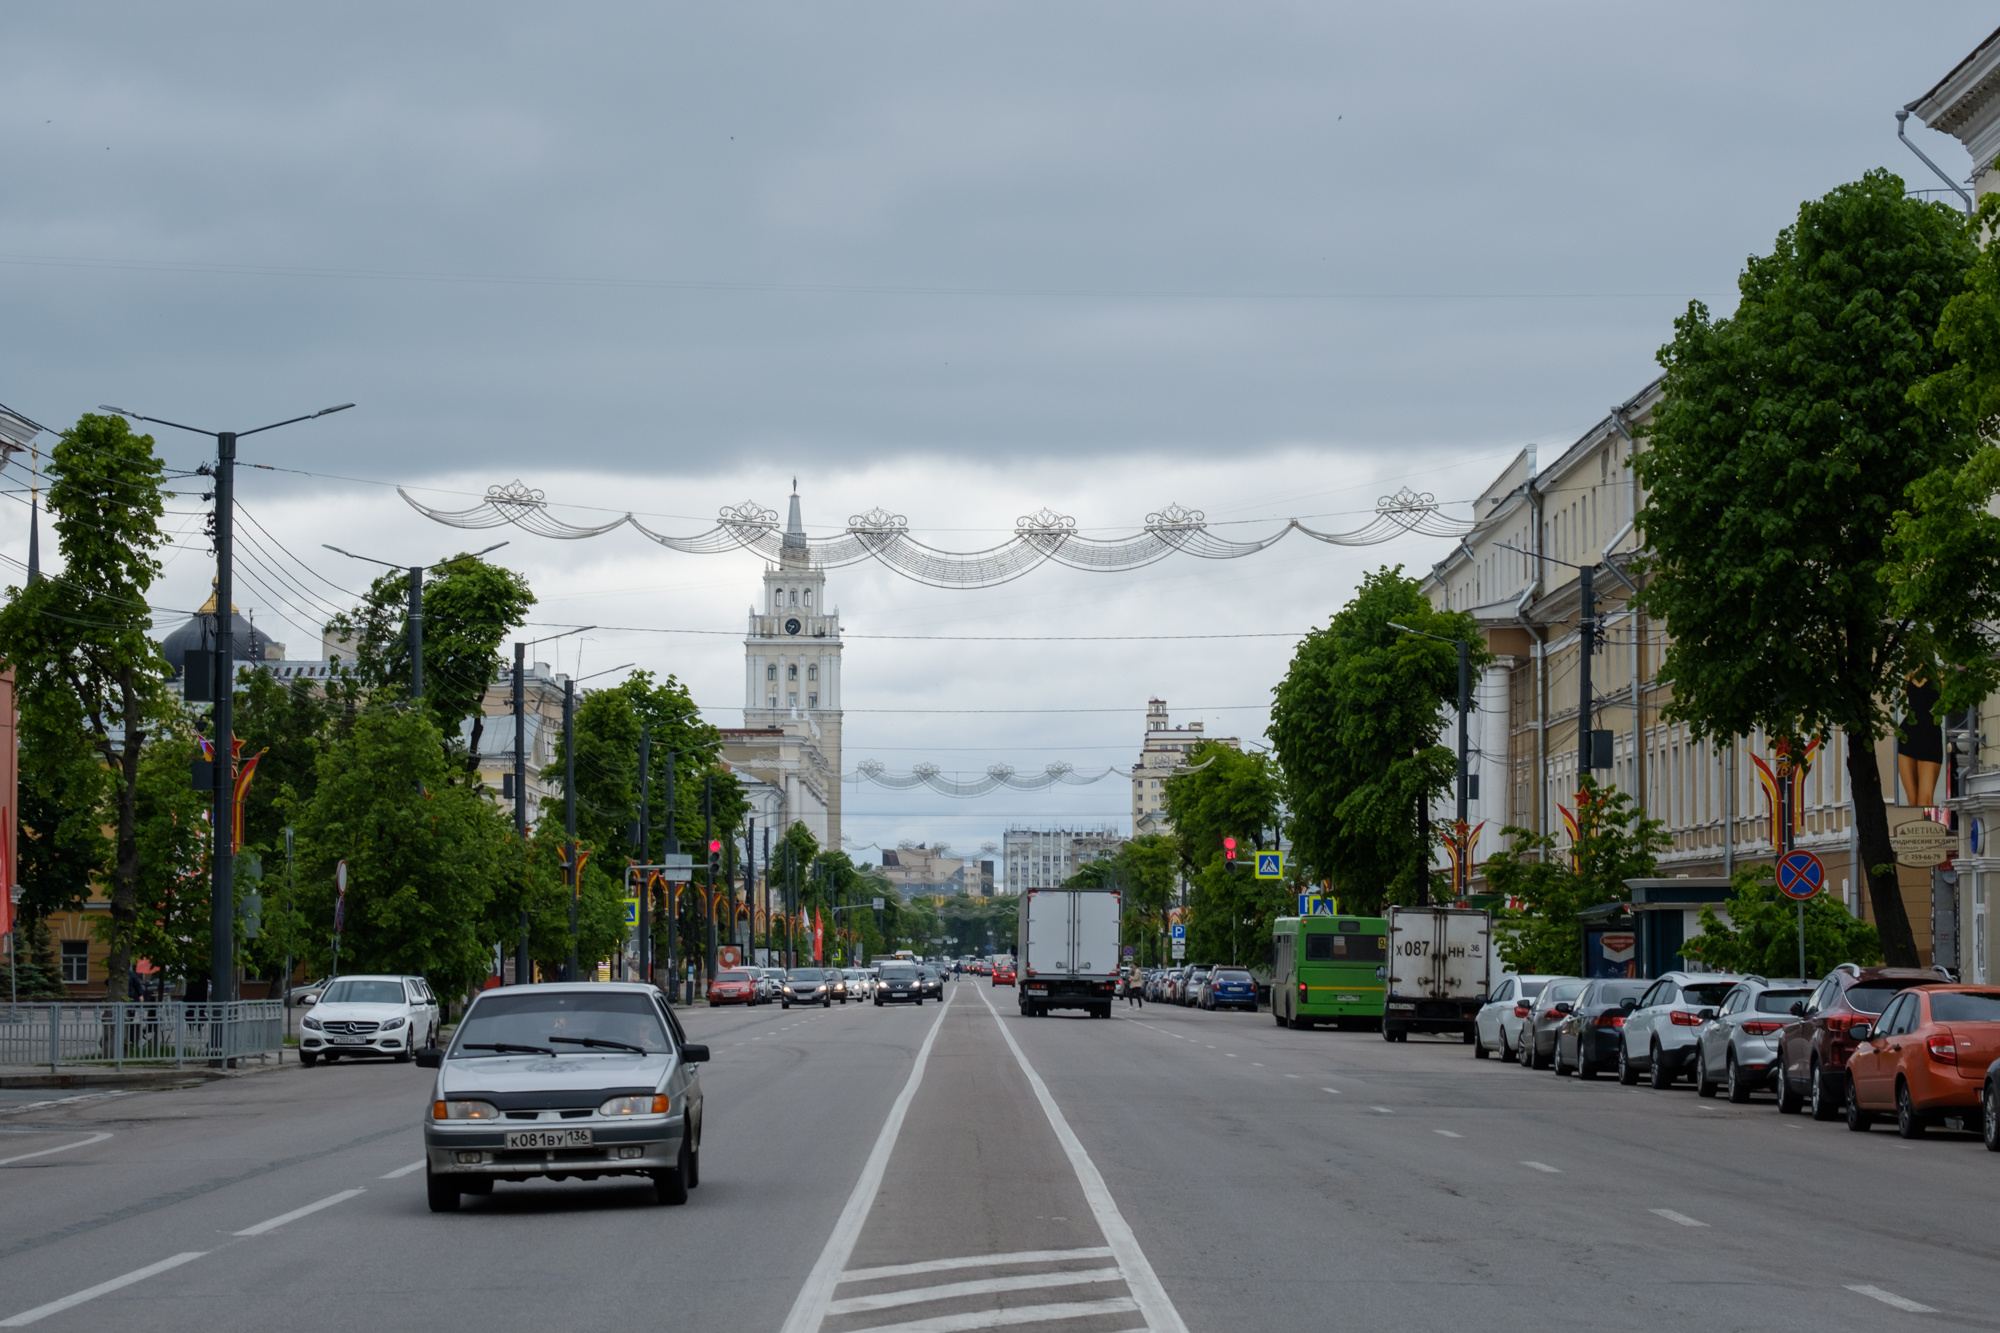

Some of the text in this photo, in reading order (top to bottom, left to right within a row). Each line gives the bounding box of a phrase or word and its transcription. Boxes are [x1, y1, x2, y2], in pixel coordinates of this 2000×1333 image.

[1175, 926, 1183, 937] P
[1448, 946, 1465, 958] НН
[1470, 944, 1480, 952] 36
[511, 1130, 588, 1147] К081ВУ 136
